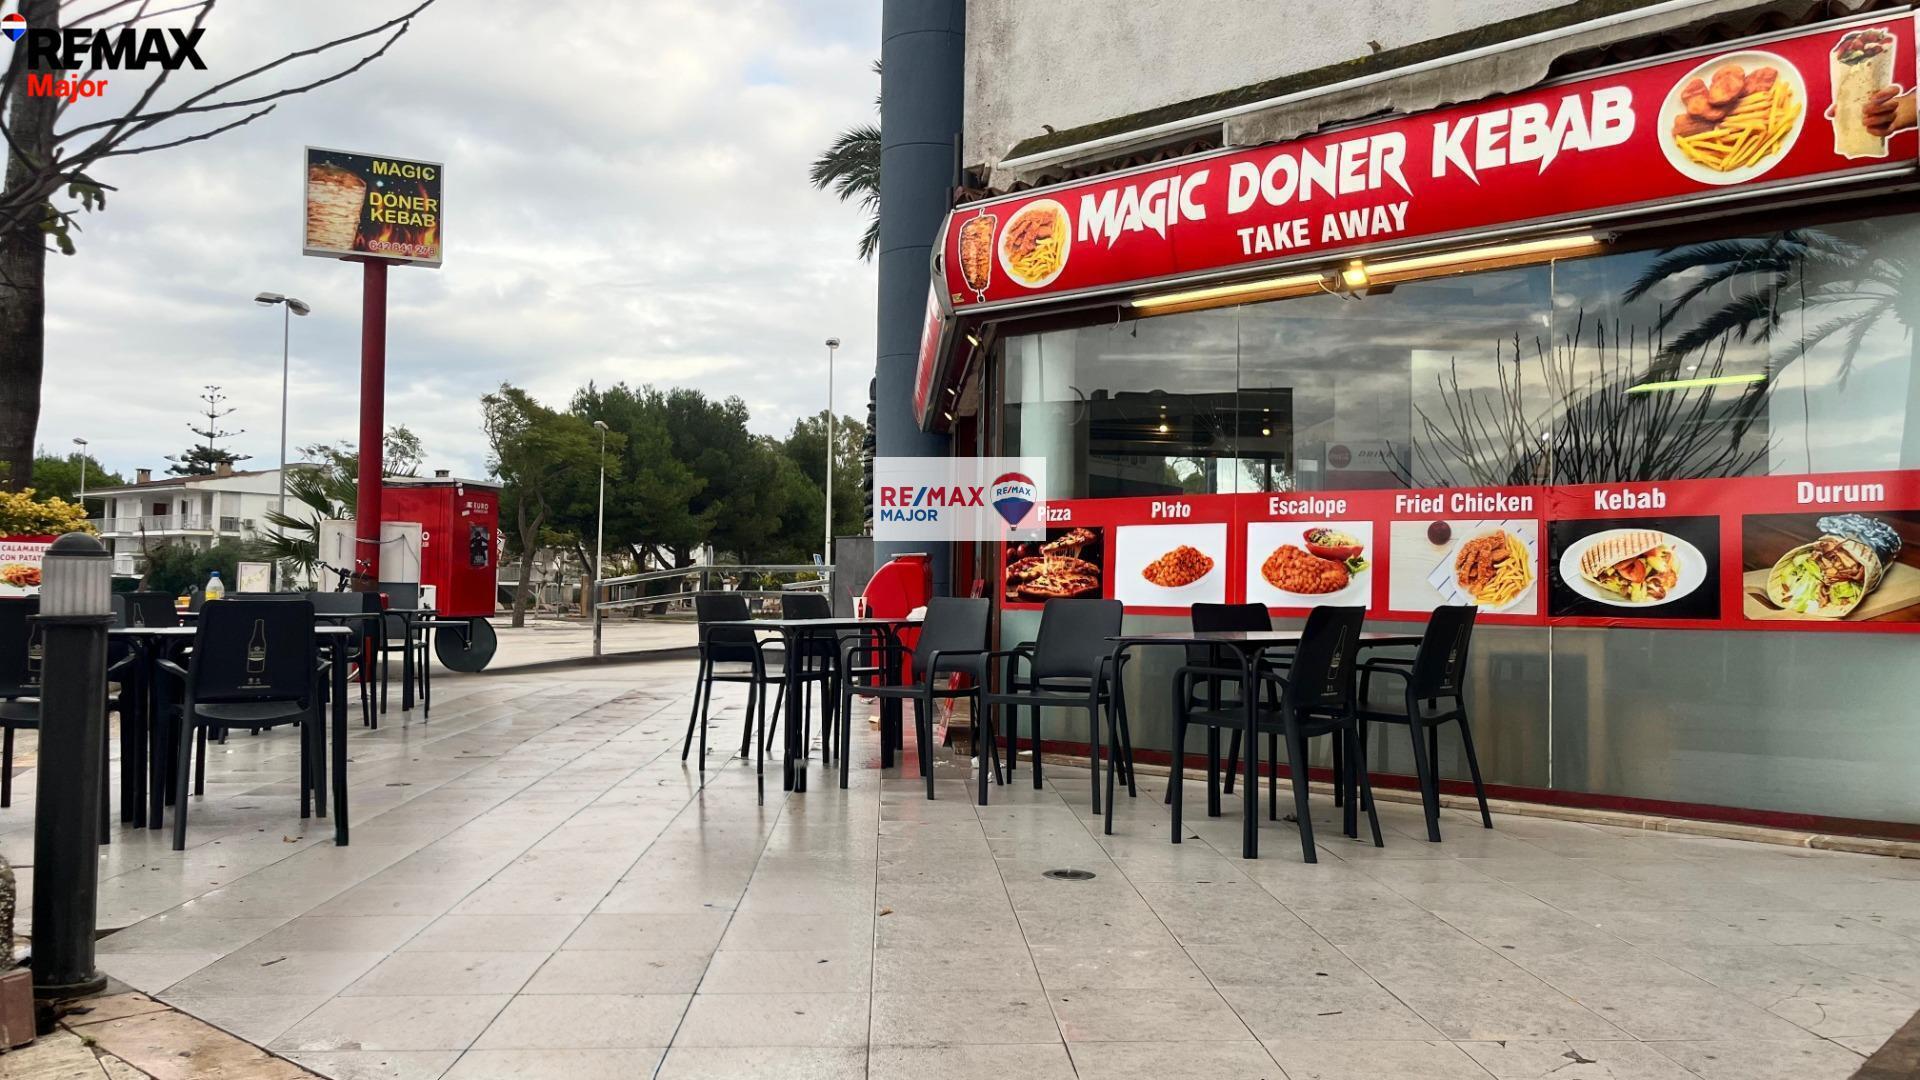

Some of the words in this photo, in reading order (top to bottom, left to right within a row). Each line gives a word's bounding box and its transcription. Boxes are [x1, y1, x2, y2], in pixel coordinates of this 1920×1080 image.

[372, 160, 436, 180] MAGIC
[1078, 169, 1210, 250] MAGIC
[1227, 131, 1414, 214] DONER
[1432, 85, 1636, 186] KEBAB
[369, 190, 438, 213] DÖNER
[370, 207, 436, 228] KEBAB
[1236, 218, 1310, 256] TAKE
[1321, 201, 1409, 243] AWAY
[1395, 494, 1444, 514] Fried
[1450, 492, 1533, 513] Chicken
[1594, 488, 1666, 510] Kebab
[1797, 481, 1884, 505] Durum
[1037, 506, 1072, 522] Pizza
[1151, 501, 1191, 518] Plato
[1268, 496, 1347, 518] Escalope
[0, 553, 16, 561] CON
